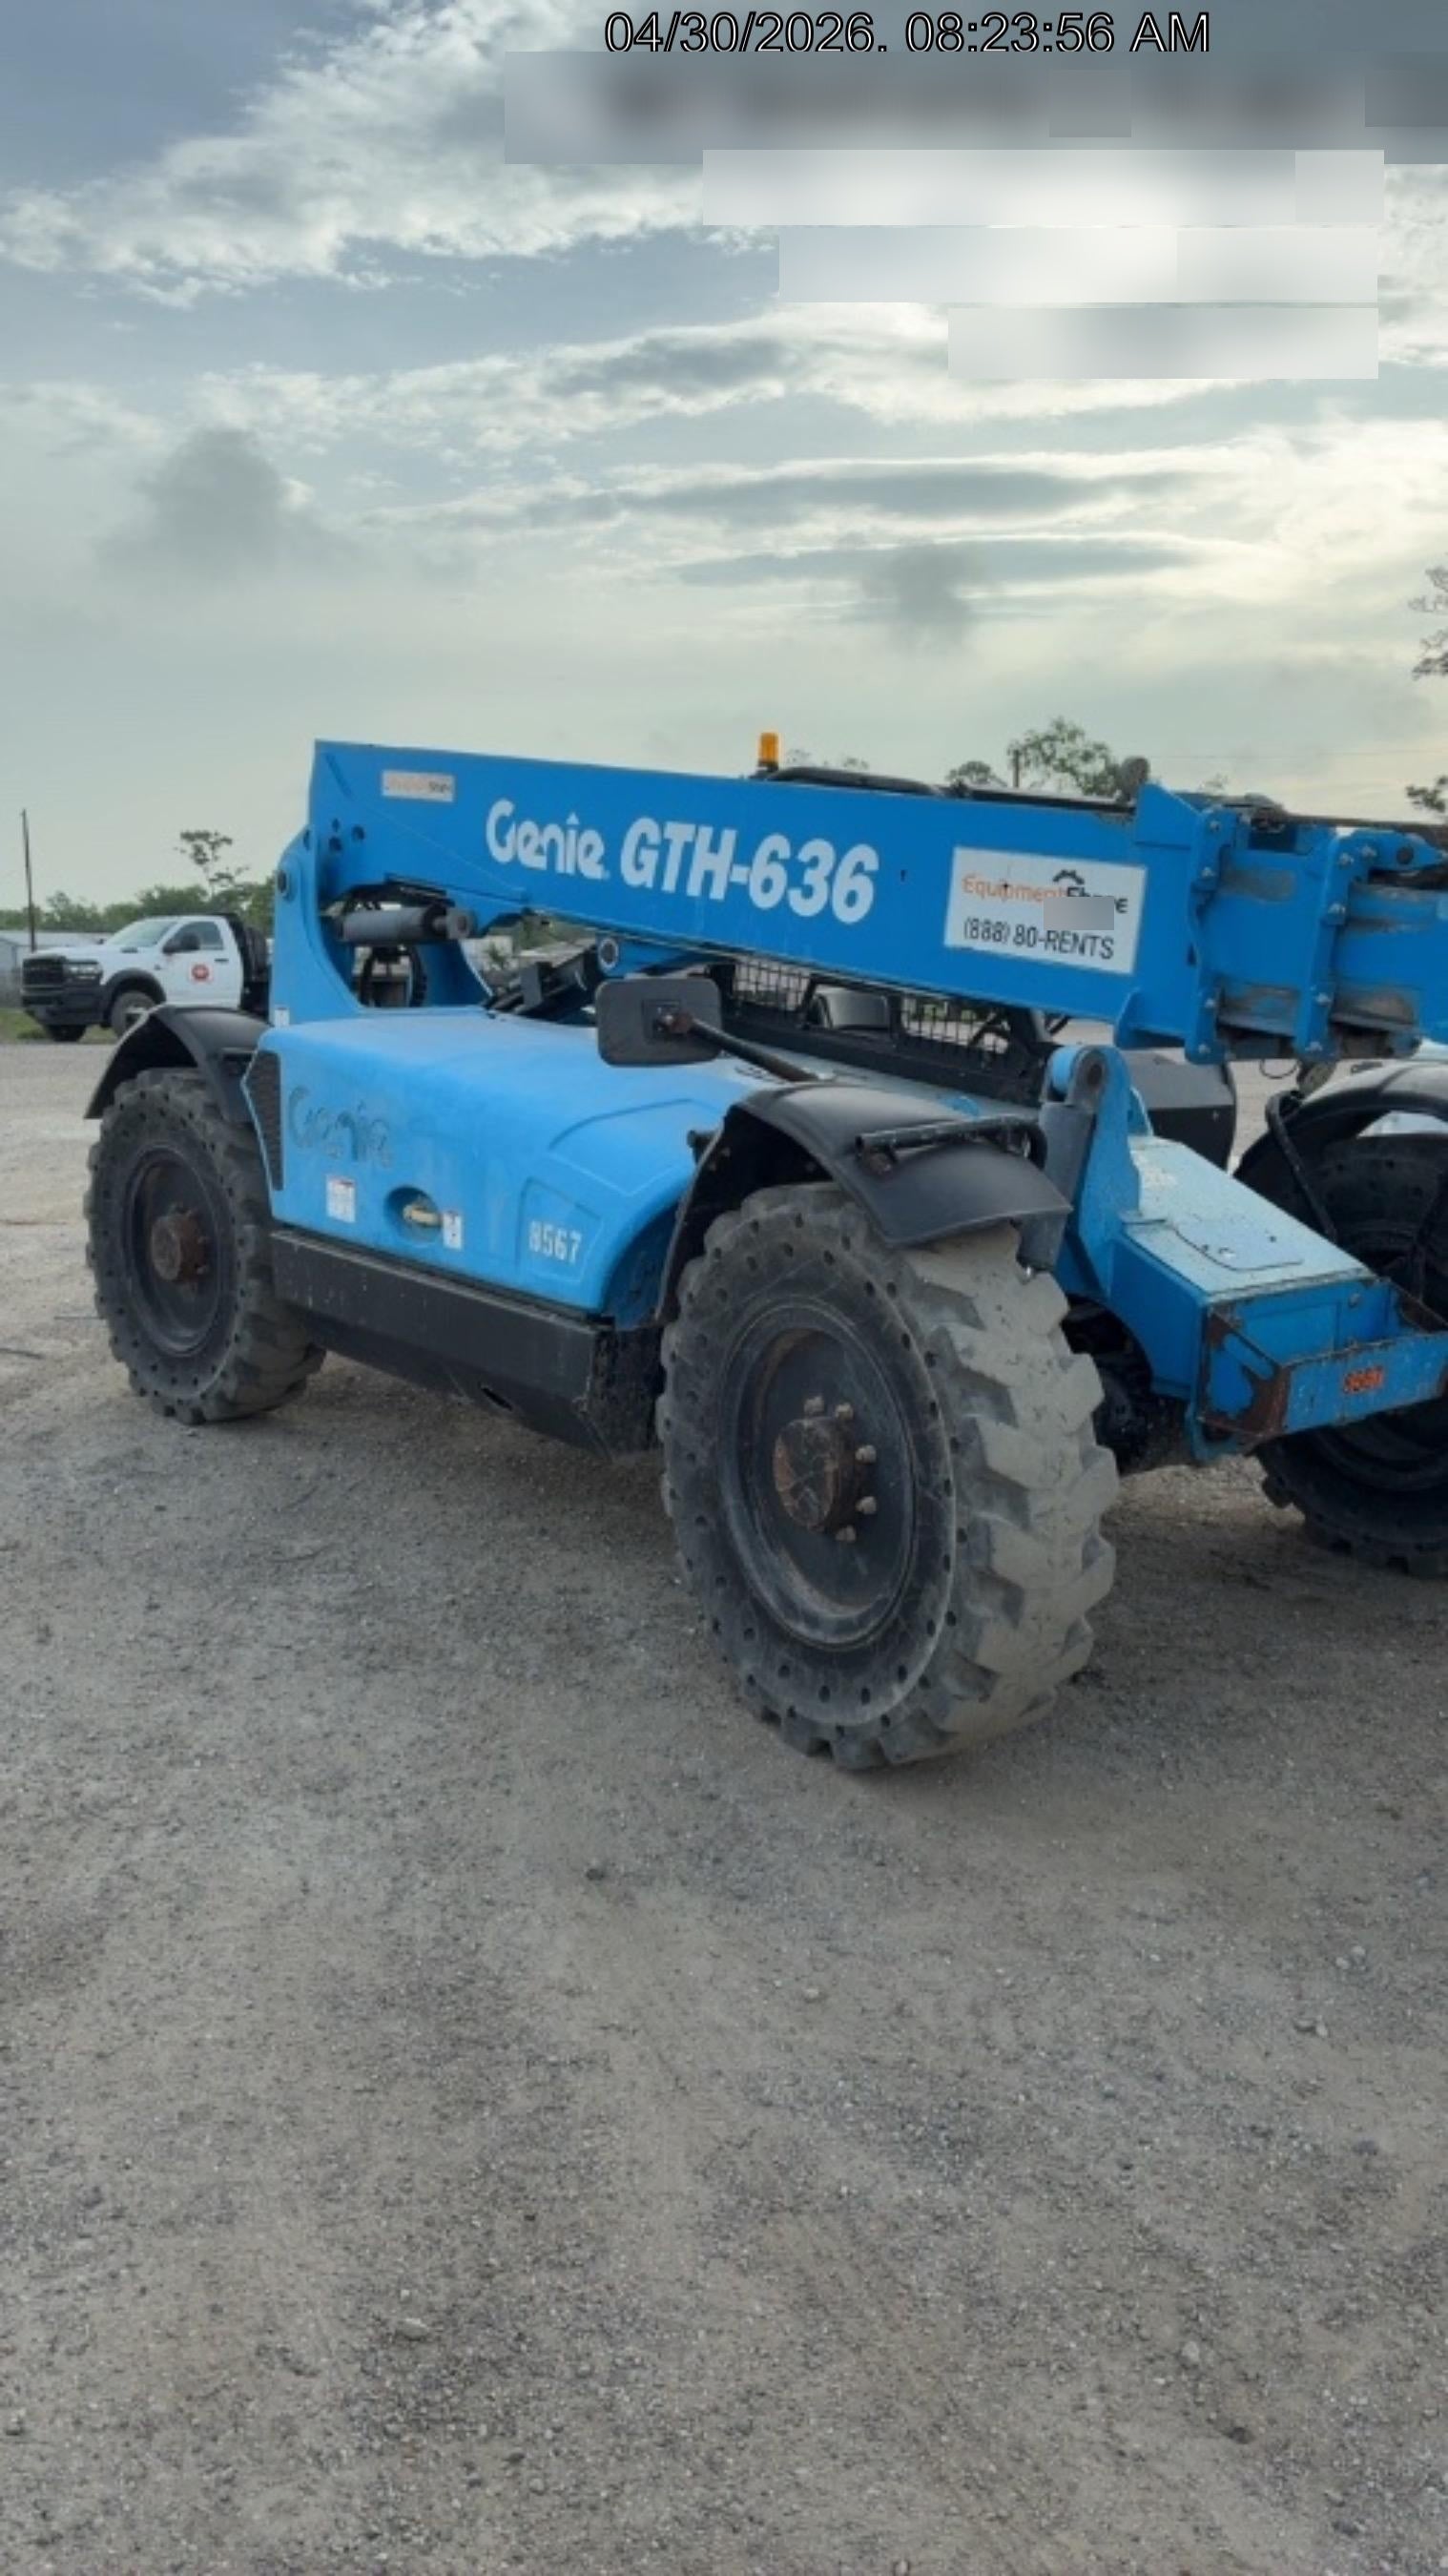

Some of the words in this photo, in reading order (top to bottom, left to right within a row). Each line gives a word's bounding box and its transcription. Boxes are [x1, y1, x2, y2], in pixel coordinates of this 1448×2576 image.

[486, 799, 605, 879] Genie
[620, 817, 879, 924] GTH-636
[964, 917, 1010, 945] (888)
[1013, 924, 1114, 960] 80-RENTS
